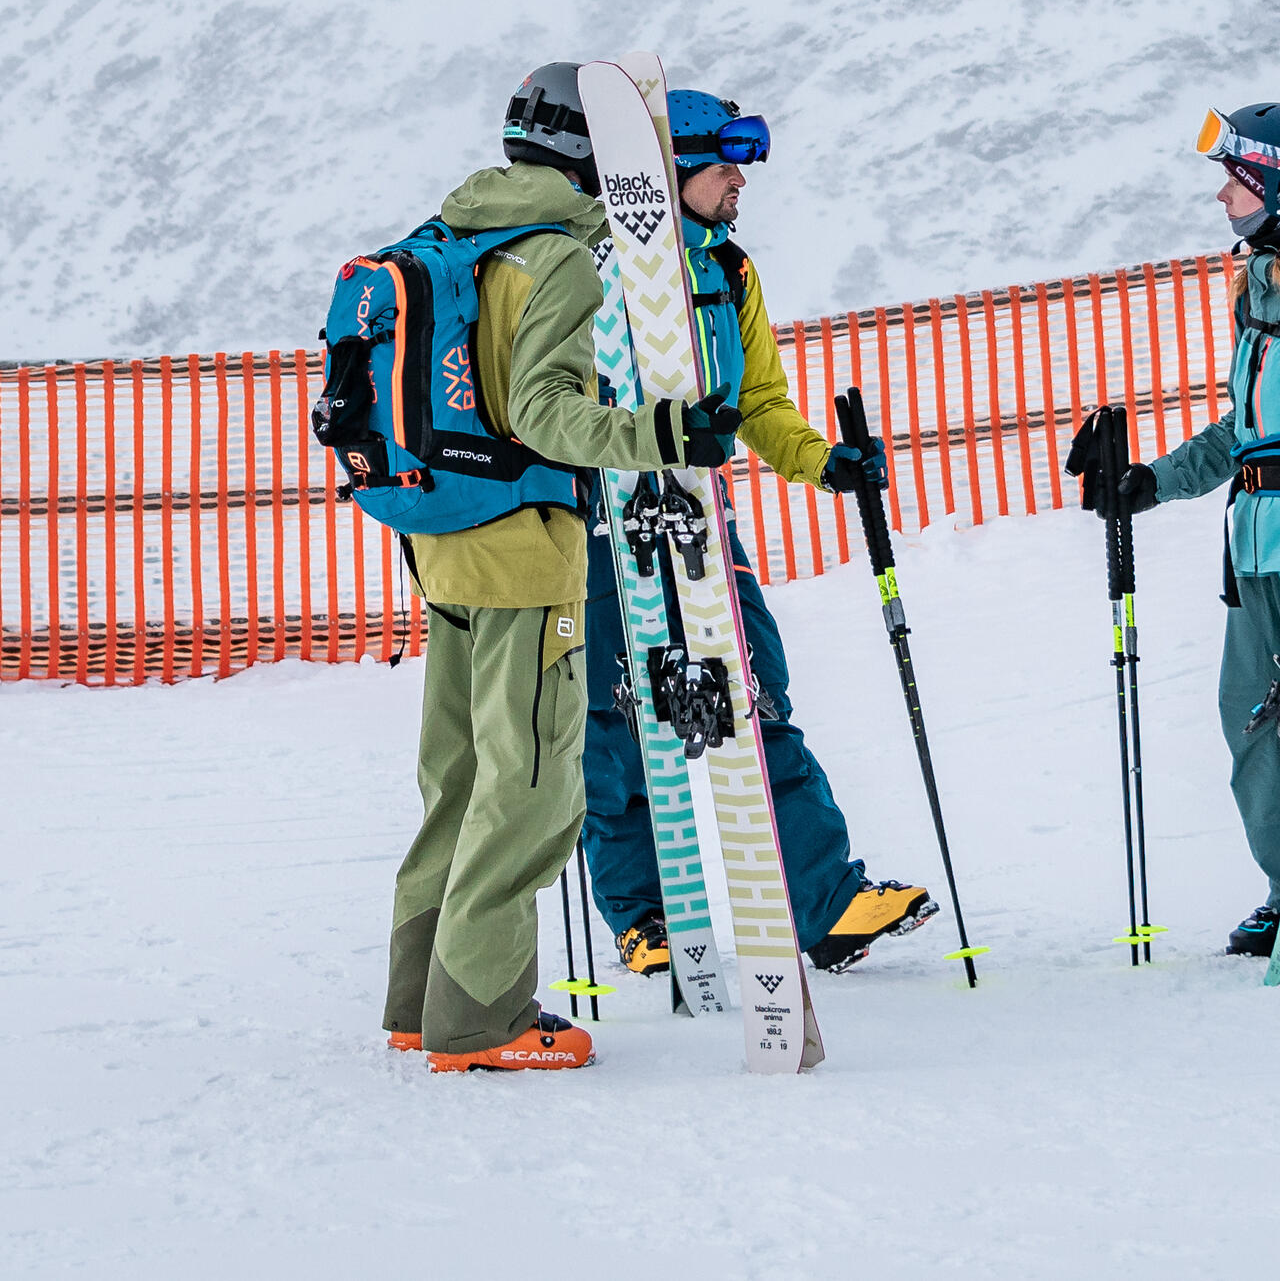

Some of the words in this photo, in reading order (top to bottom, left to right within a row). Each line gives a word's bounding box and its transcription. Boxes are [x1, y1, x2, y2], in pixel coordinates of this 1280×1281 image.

[604, 171, 653, 193] black
[609, 189, 665, 206] crows
[494, 249, 527, 266] ORTOVOX
[442, 448, 493, 464] ORTOVOX
[754, 1005, 791, 1014] blackcrows
[763, 1013, 783, 1021] anima
[760, 1042, 772, 1050] 11.5
[500, 1051, 577, 1062] SCARPA
